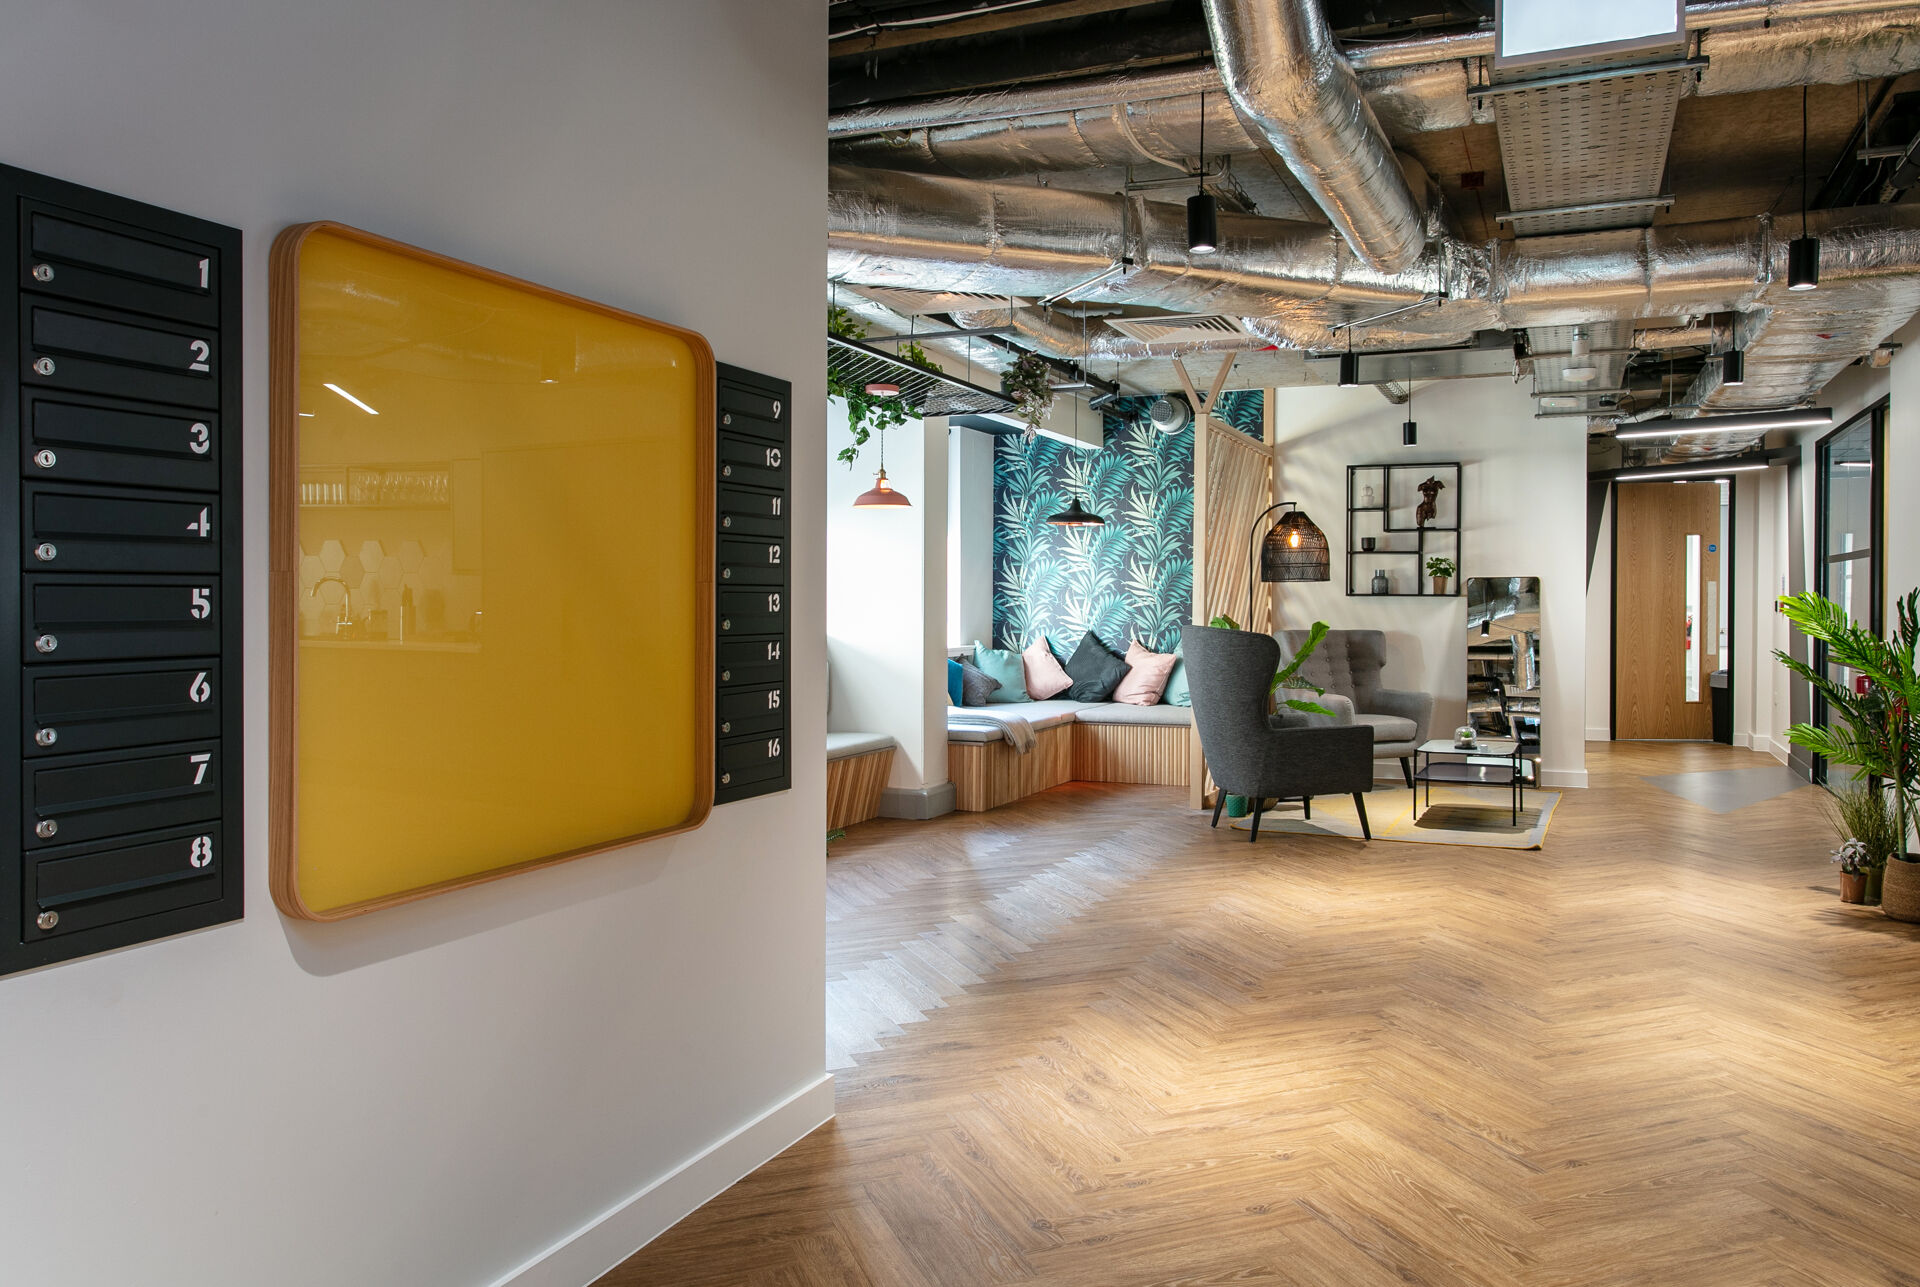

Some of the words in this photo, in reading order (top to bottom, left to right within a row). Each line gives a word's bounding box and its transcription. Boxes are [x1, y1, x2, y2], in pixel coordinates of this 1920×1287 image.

[199, 258, 209, 289] 1
[189, 339, 210, 372] 2
[772, 400, 781, 419] 9
[189, 422, 210, 454] 3
[765, 447, 782, 468] 10
[772, 496, 781, 516] 11
[186, 507, 211, 537] 4
[768, 545, 781, 564] 12
[190, 588, 211, 619] 5
[768, 593, 781, 613] 13
[767, 641, 781, 661] 14
[189, 671, 211, 703] 6
[768, 689, 781, 710] 15
[767, 737, 781, 758] 16
[190, 753, 211, 785] 7
[190, 835, 213, 868] 8
